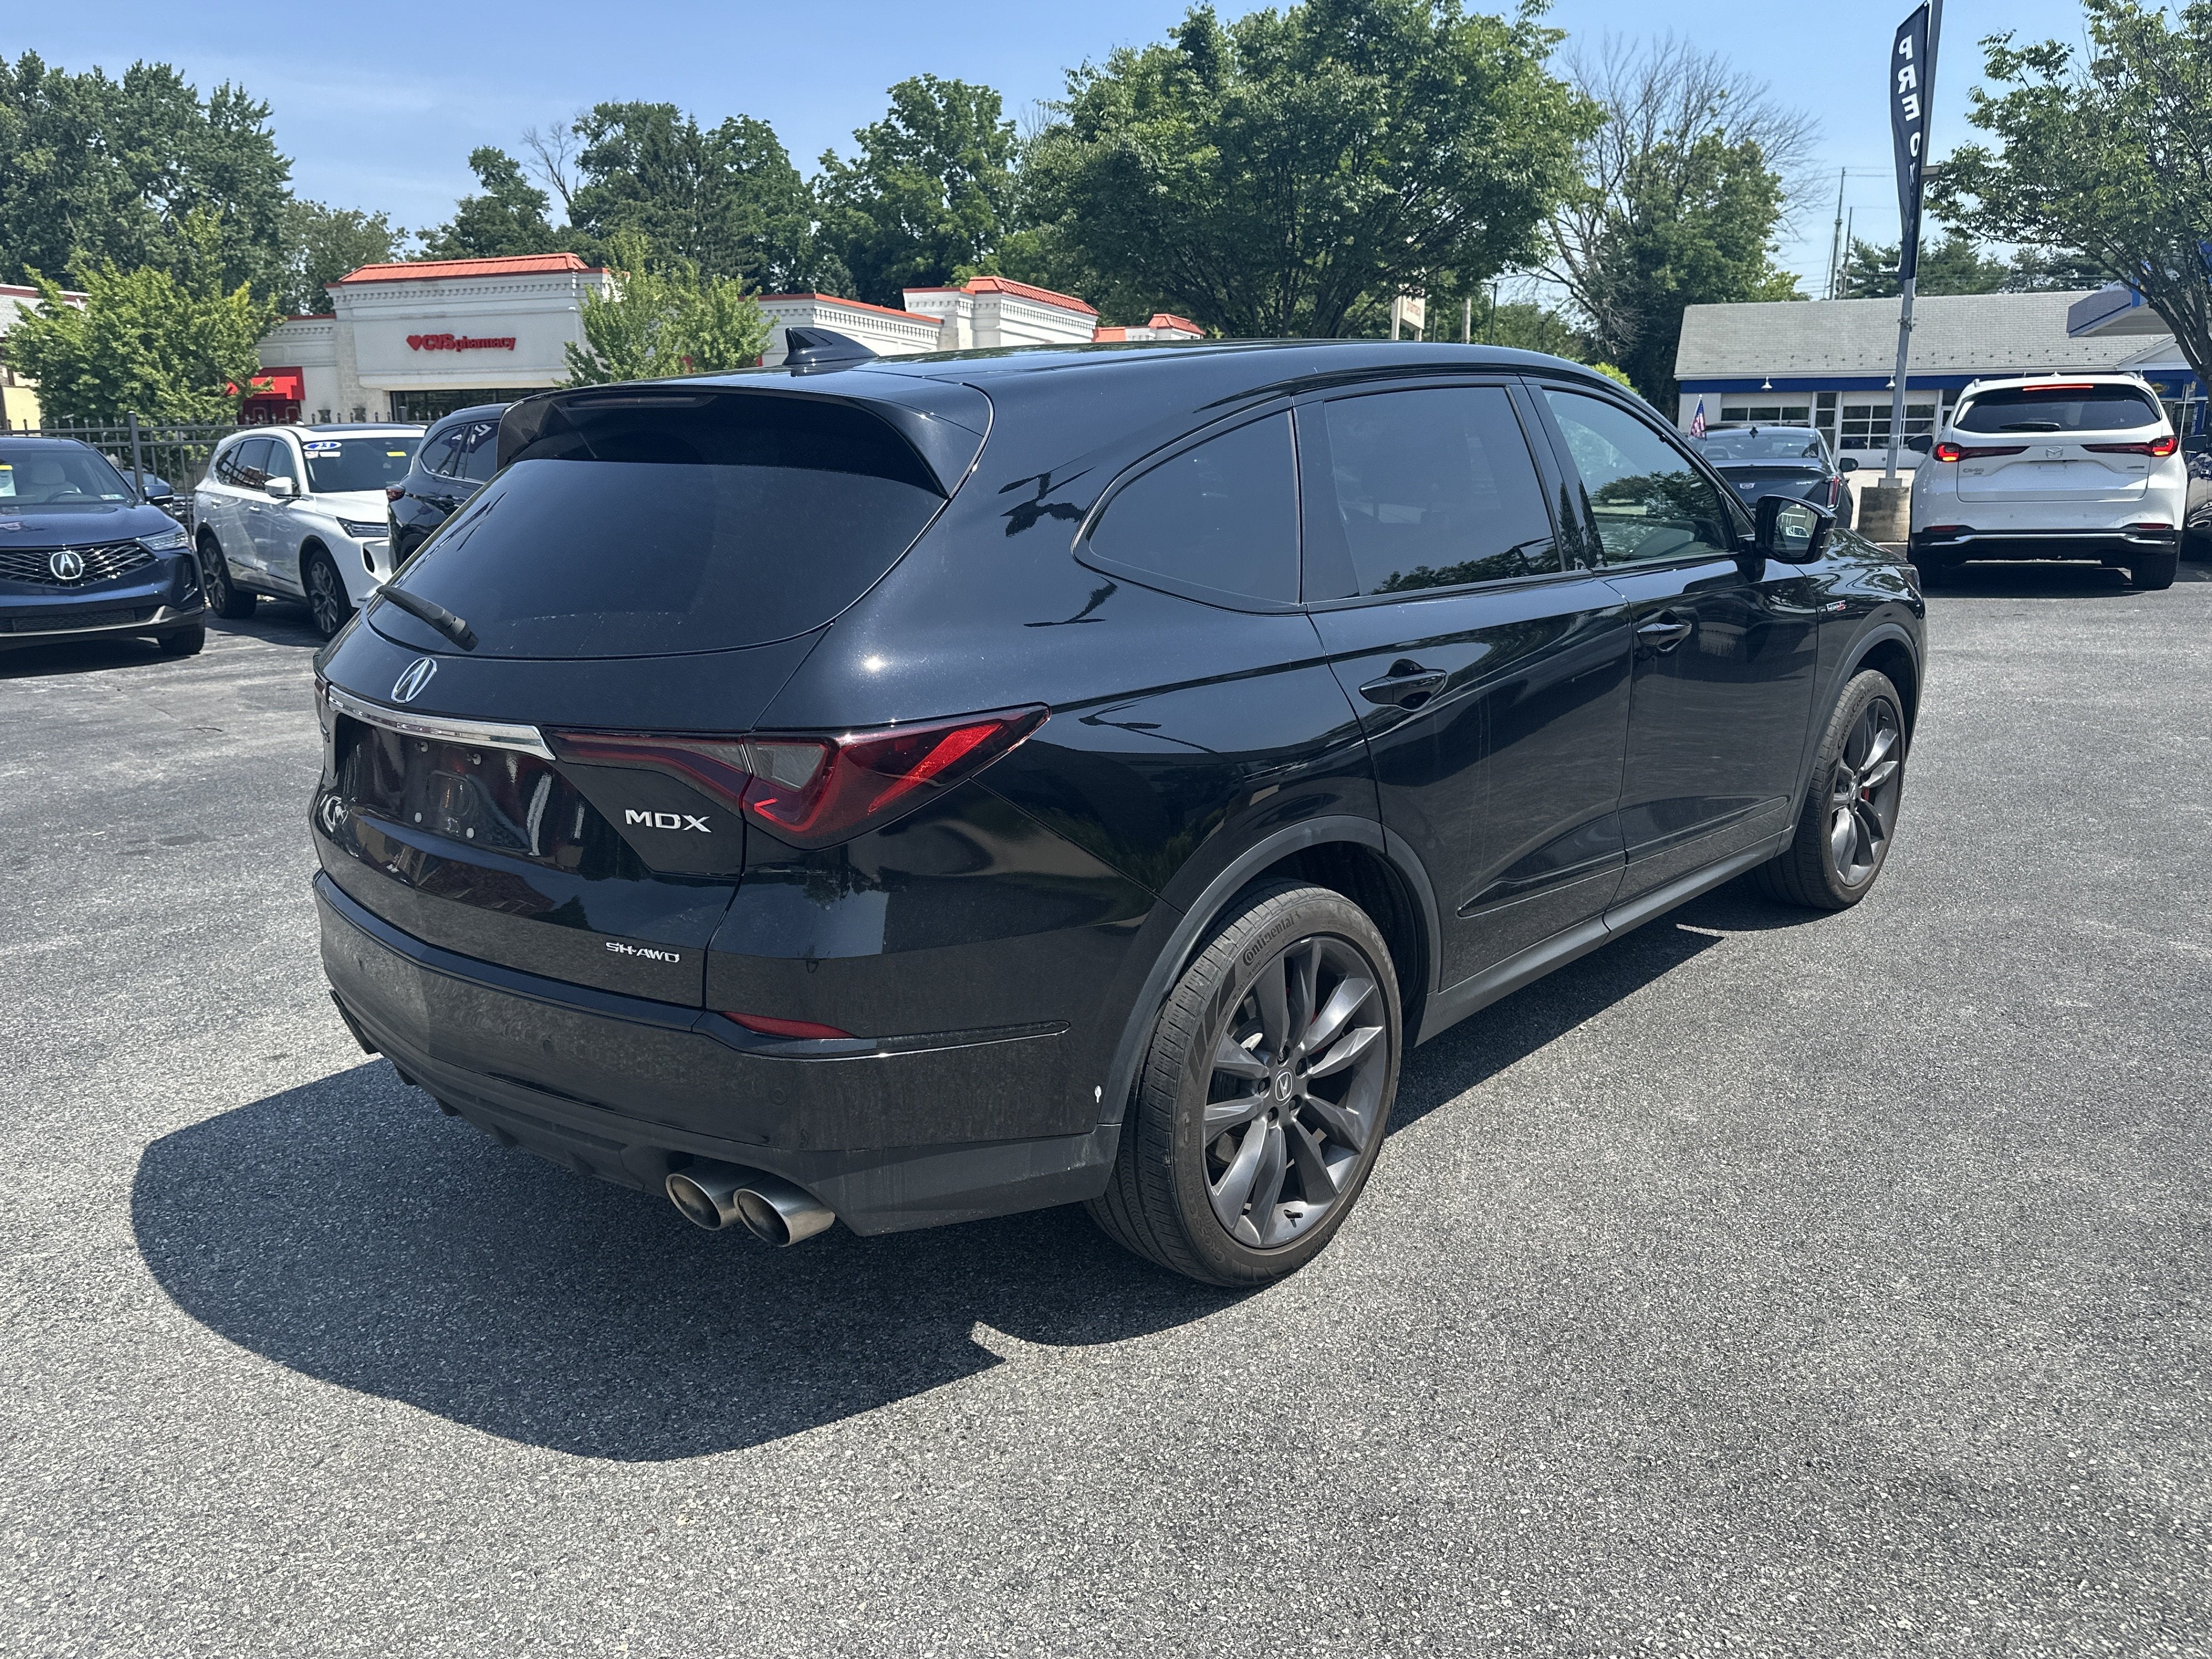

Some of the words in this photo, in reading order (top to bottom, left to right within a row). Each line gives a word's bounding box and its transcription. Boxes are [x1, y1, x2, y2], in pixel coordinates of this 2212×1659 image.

[421, 333, 456, 351] CVS
[455, 335, 516, 352] pharmacy
[625, 809, 712, 833] MDX
[1242, 913, 1295, 967] Continental
[605, 941, 680, 963] SH-AWD
